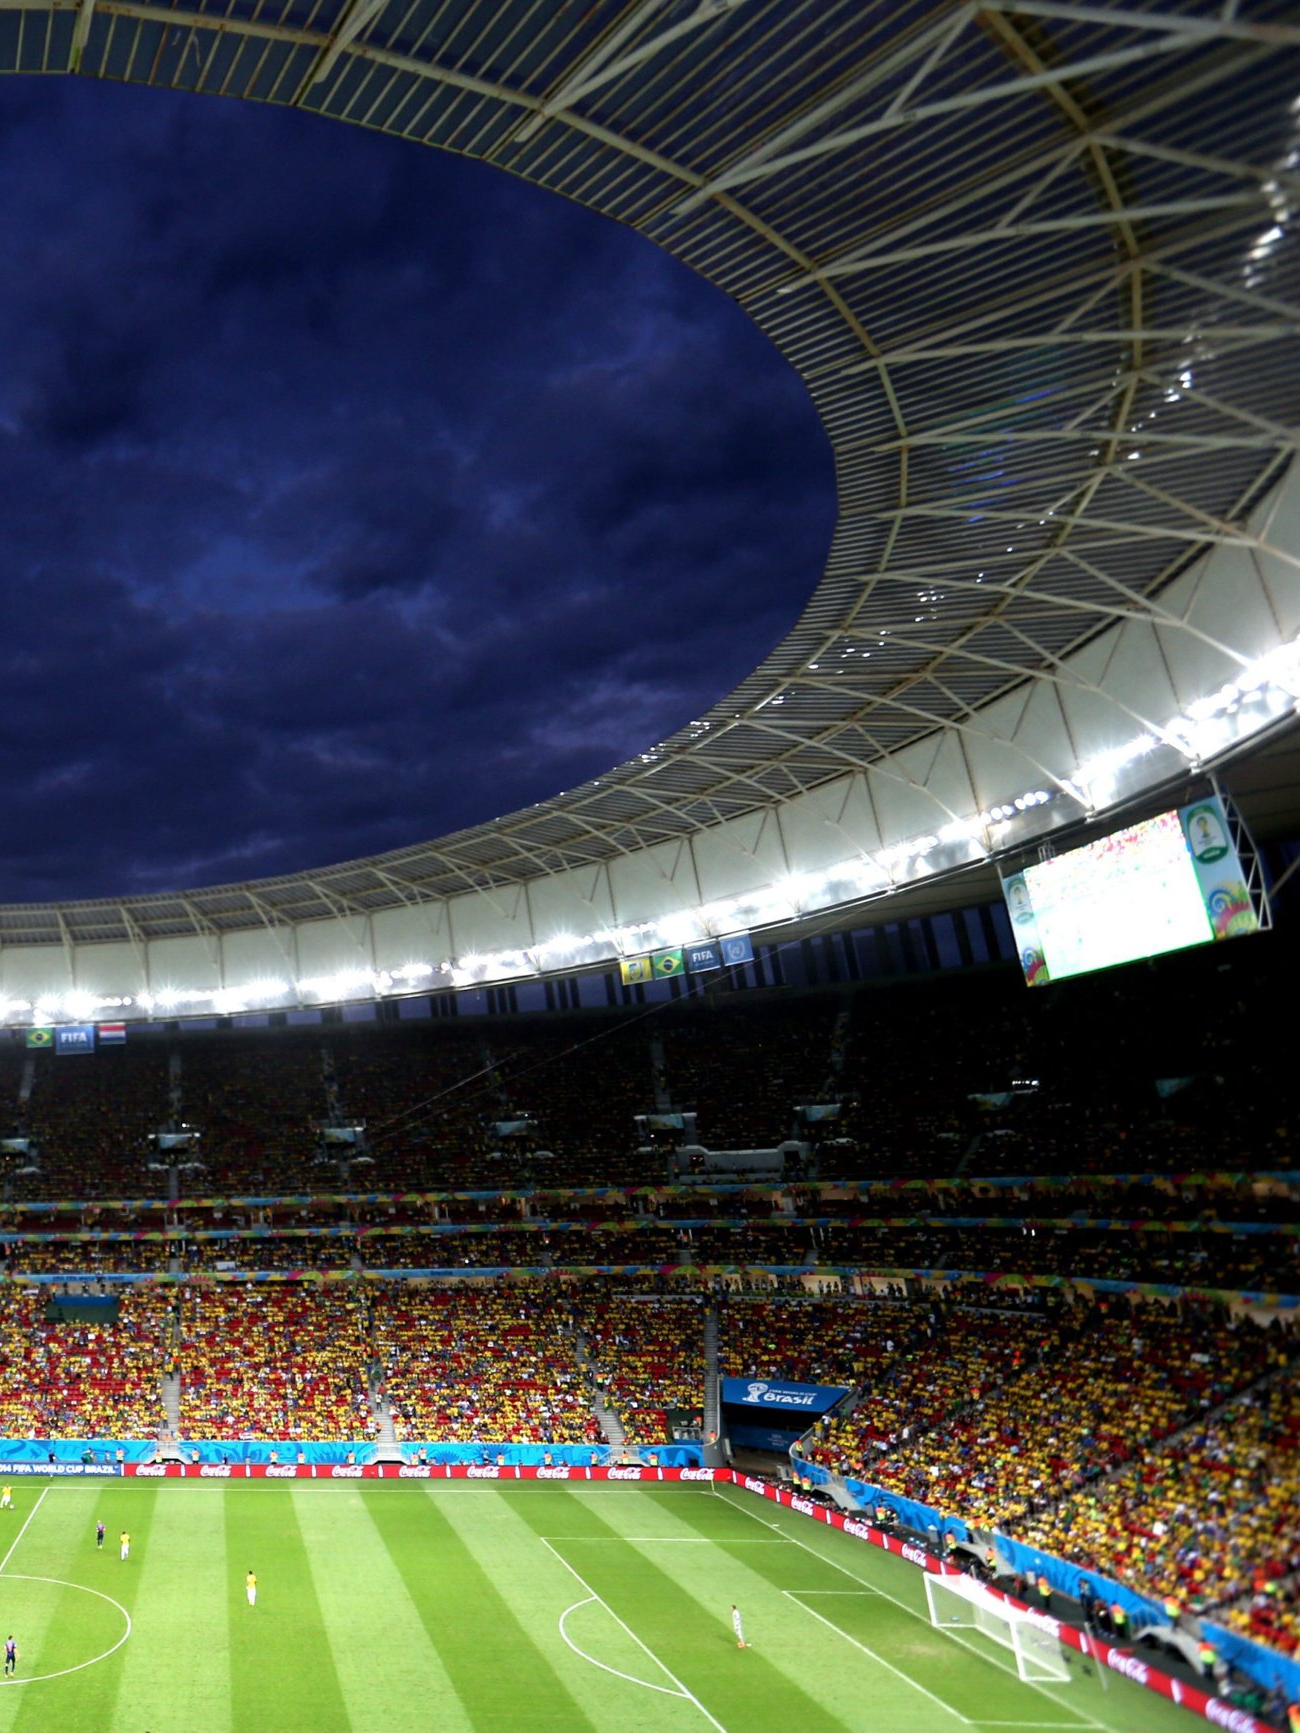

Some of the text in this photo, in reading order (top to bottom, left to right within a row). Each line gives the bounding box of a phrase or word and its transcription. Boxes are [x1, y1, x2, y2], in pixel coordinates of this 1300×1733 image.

[692, 950, 714, 963] FIFA
[60, 1031, 88, 1043] FIFA
[13, 1464, 32, 1473] FIFA
[33, 1464, 65, 1474] WORLD
[66, 1465, 84, 1474] CUP
